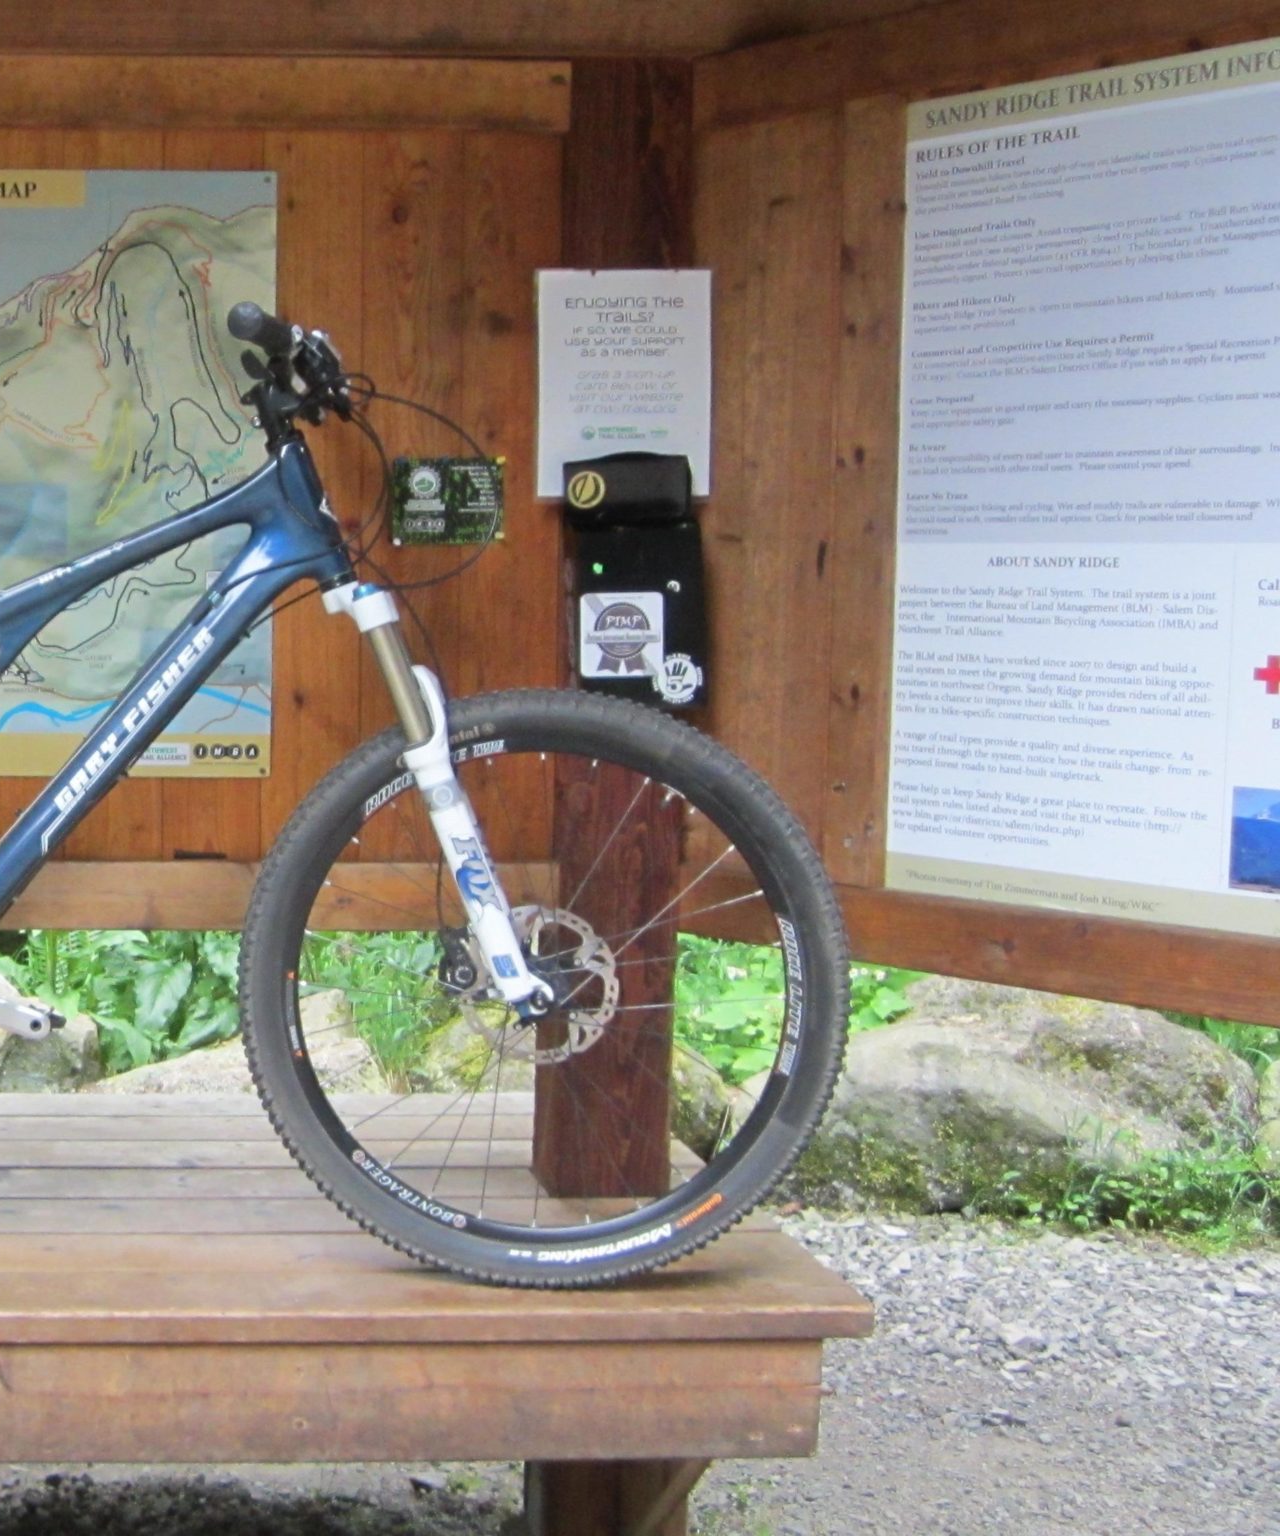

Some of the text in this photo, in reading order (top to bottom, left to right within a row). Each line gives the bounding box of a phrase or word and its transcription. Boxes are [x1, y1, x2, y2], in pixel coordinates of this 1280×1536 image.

[926, 100, 990, 128] SANDY
[995, 88, 1060, 116] RIDGE
[1065, 77, 1128, 104] TRAIL
[1134, 60, 1219, 94] SYSTEM
[916, 126, 1080, 163] RULES OF THE TRAIL
[996, 156, 1025, 169] Travel
[967, 345, 983, 354] and
[1120, 333, 1154, 344] Permit
[987, 556, 1120, 568] ABOUT SANDY RIDGE
[941, 586, 950, 594] to
[952, 586, 967, 595] the
[969, 586, 995, 598] Sandy
[998, 587, 1023, 598] Ridge
[1026, 588, 1047, 597] Trail
[1091, 588, 1110, 599] The
[1112, 589, 1132, 599] trail
[1135, 591, 1169, 602] system
[1172, 591, 1180, 600] is
[1192, 591, 1216, 603] joint
[946, 613, 1218, 630] International Mountain Bicycling Association (IMBA) and
[122, 627, 215, 732] FISHER
[54, 732, 118, 812] GARY
[451, 836, 506, 912] FOX
[361, 1159, 456, 1228] BONTRAGER
